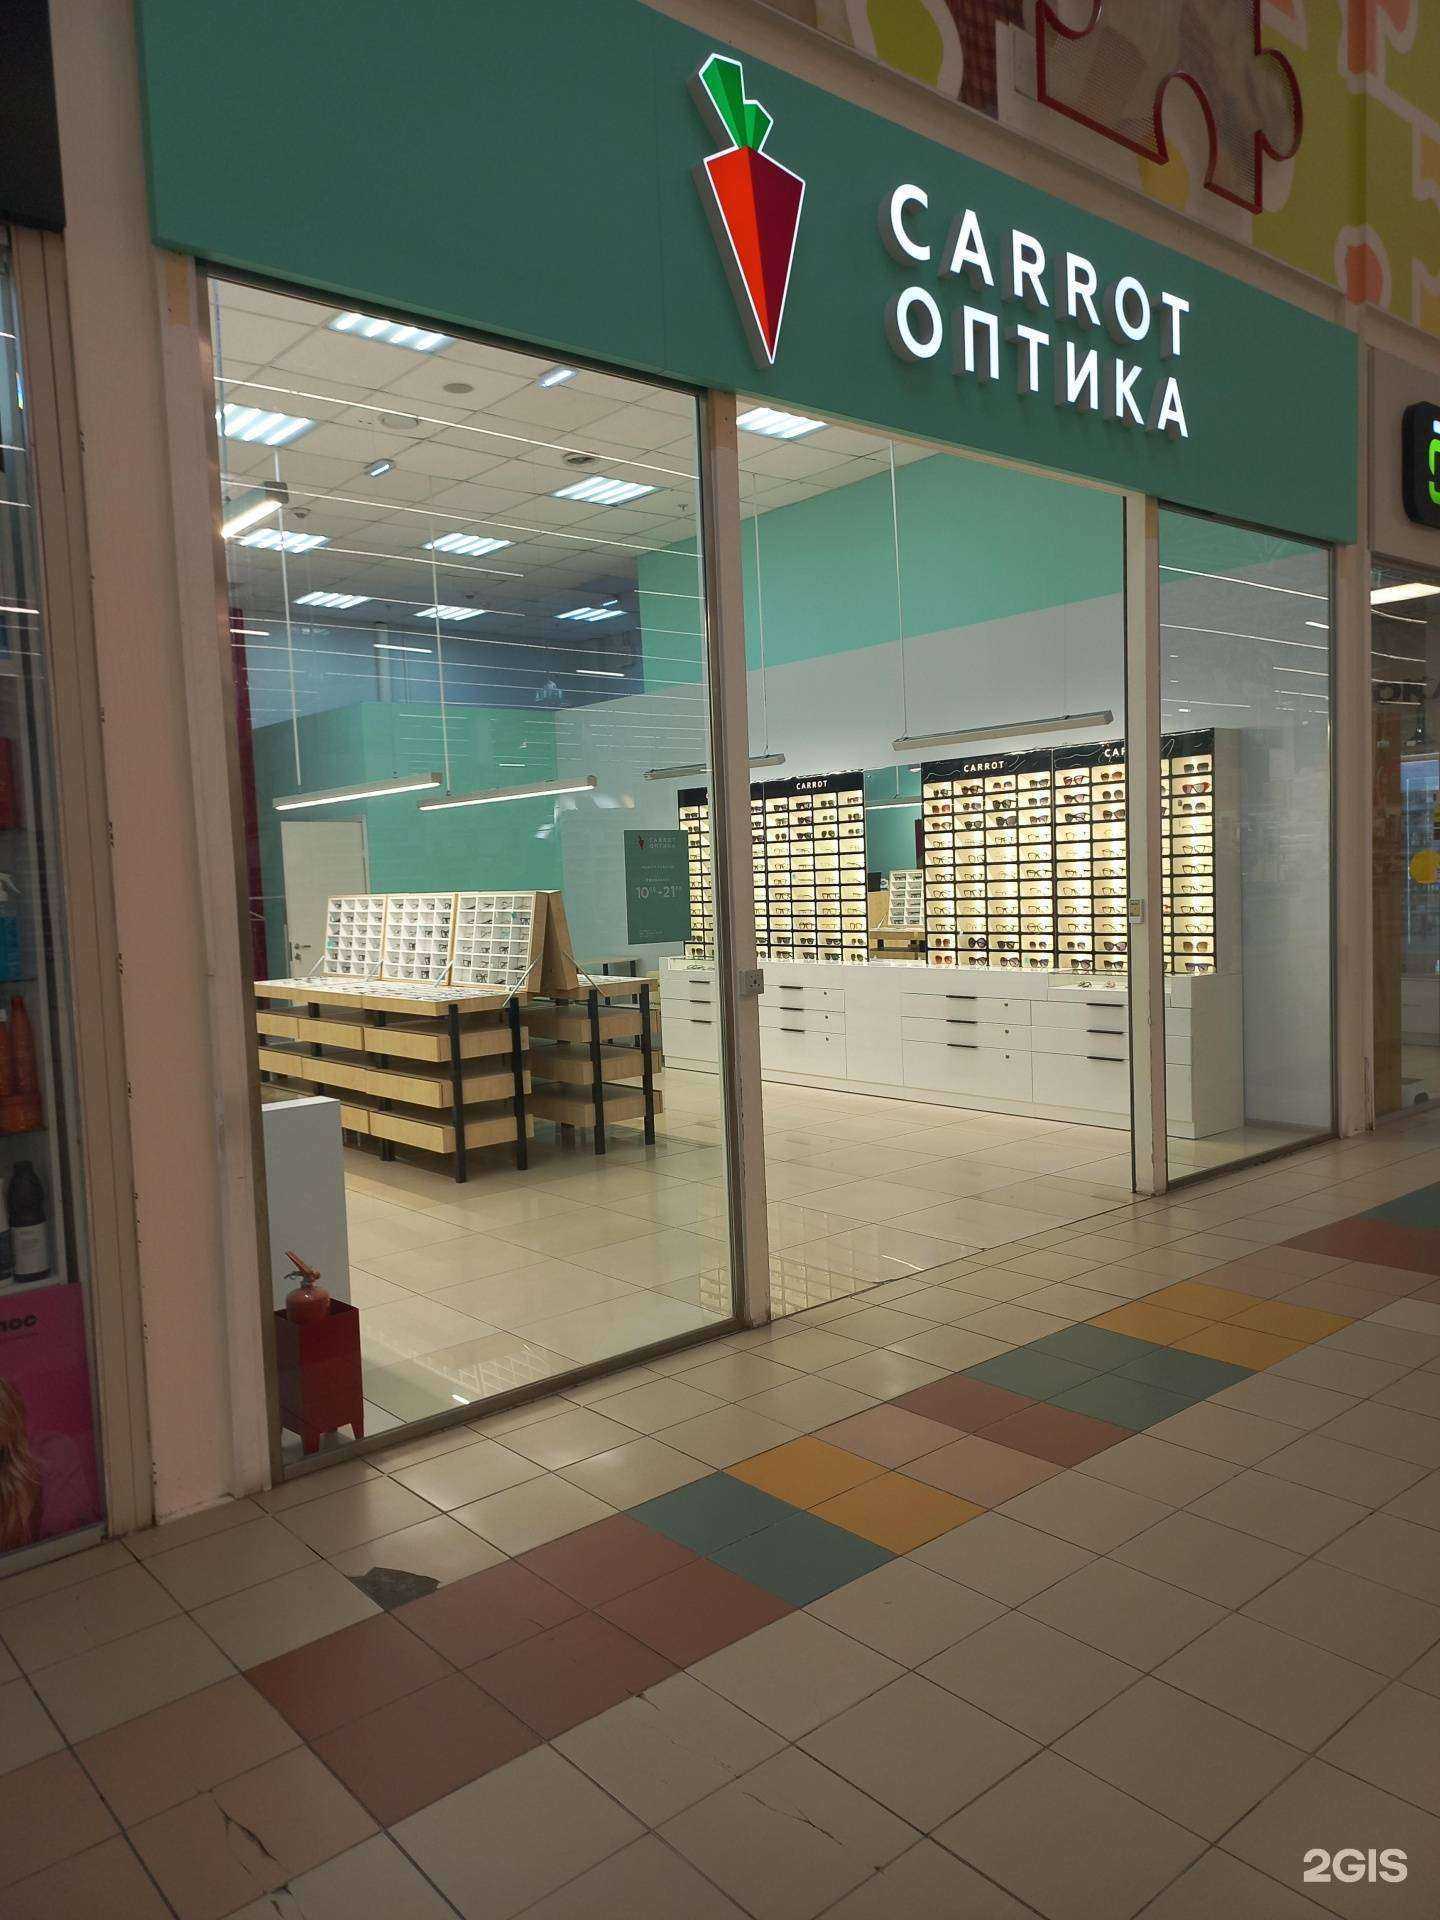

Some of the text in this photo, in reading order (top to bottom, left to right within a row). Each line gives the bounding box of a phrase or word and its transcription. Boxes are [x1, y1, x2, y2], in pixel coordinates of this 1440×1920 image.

[890, 183, 1190, 356] CARROT
[896, 286, 1189, 438] ОПТИКА
[796, 780, 828, 790] CARROT
[963, 760, 1005, 773] CARROT
